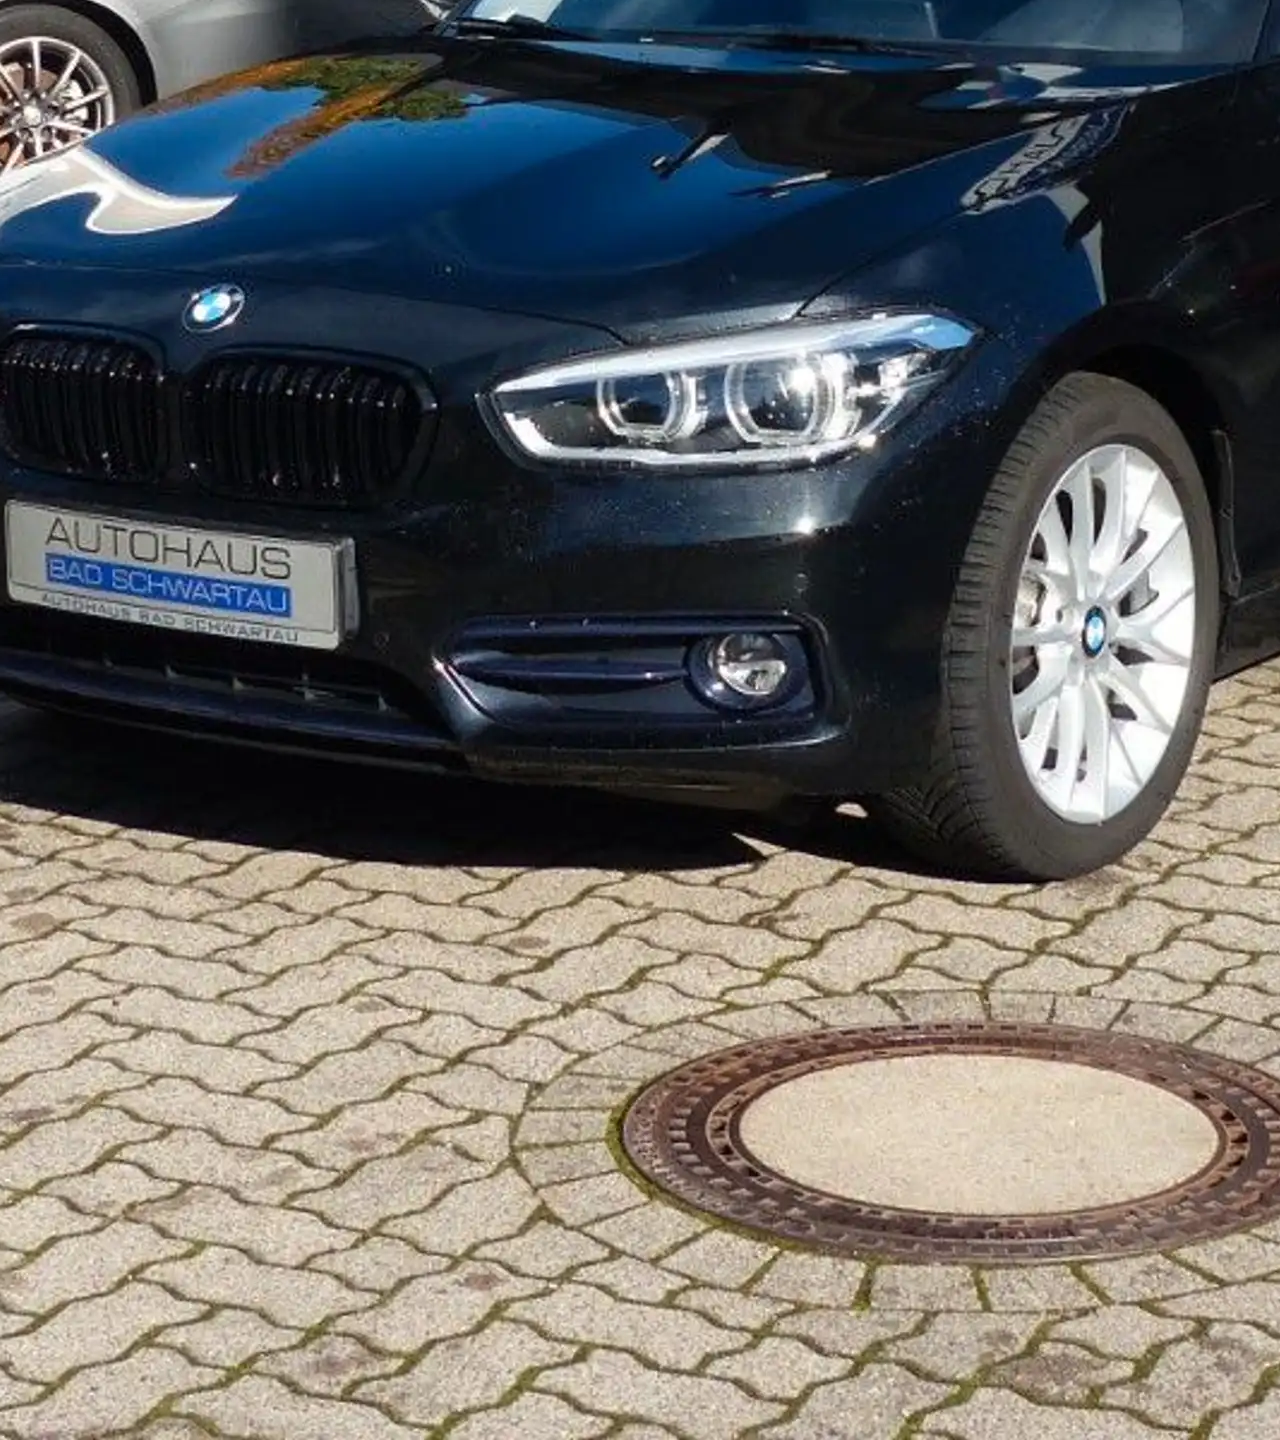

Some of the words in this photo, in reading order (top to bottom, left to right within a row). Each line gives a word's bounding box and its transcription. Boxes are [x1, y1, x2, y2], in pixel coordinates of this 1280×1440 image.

[45, 516, 292, 581] AUTOHAUS
[48, 559, 103, 586] BAD
[111, 567, 289, 613] SCHWARTAU
[41, 592, 132, 622] AUTOHAUS
[138, 609, 176, 627] BAD
[183, 617, 300, 643] SCHWARTAU
